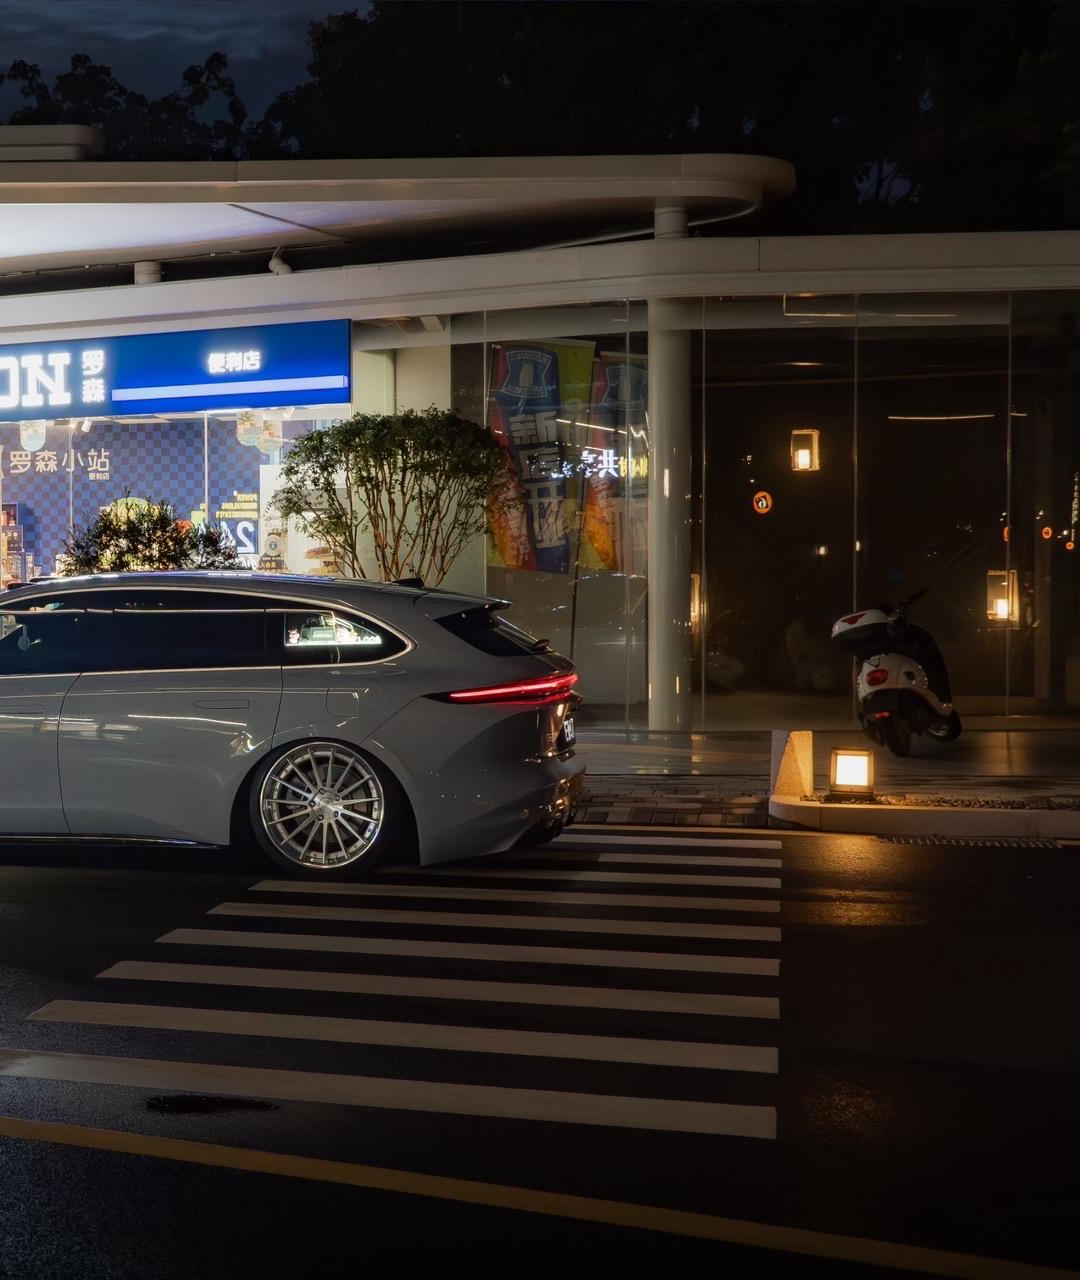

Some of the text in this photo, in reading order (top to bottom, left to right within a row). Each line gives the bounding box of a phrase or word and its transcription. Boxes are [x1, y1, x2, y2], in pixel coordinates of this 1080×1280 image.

[208, 350, 260, 373] 便利店
[82, 350, 105, 403] 罗森
[10, 448, 110, 474] 罗森小站
[88, 472, 110, 480] 便利店
